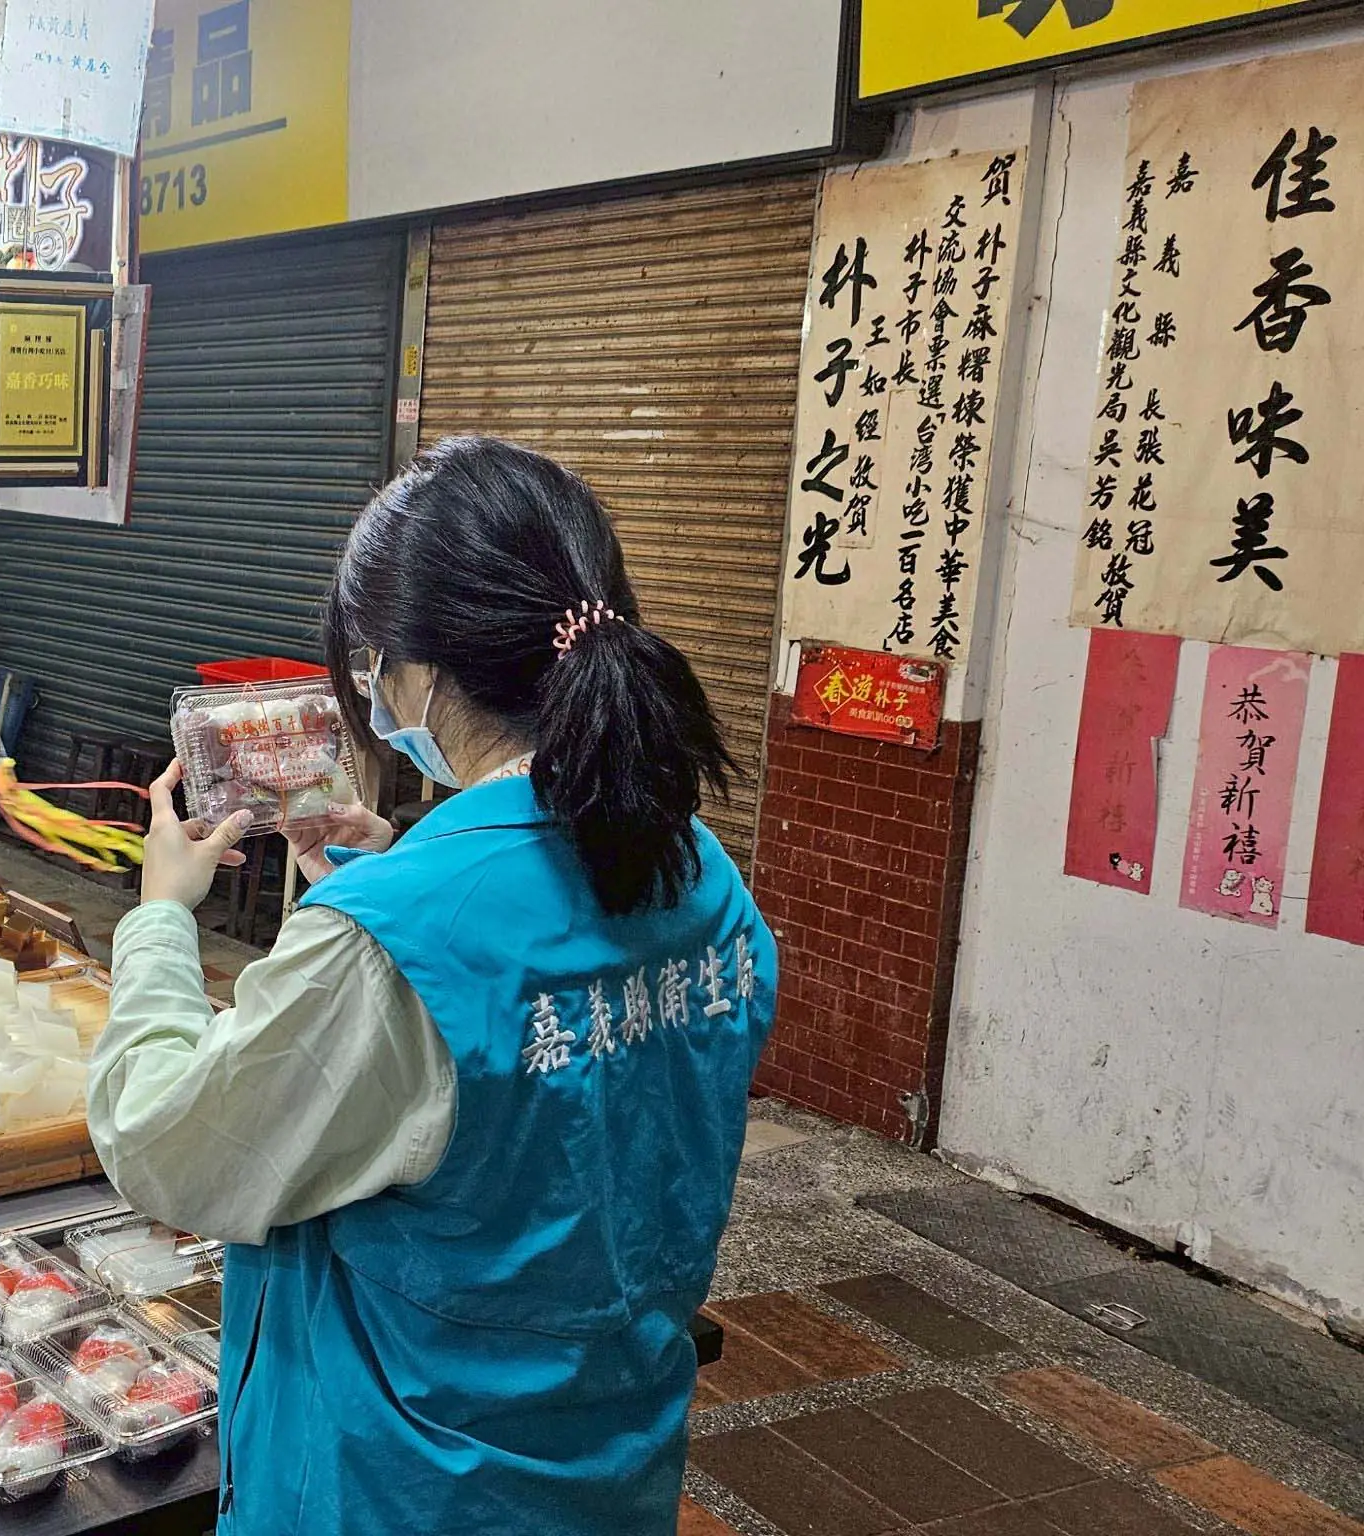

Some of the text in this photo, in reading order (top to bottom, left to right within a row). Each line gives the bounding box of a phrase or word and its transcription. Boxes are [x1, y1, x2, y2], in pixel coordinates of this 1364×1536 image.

[1209, 126, 1338, 592] 佳香味美
[1217, 683, 1277, 866] 恭賀新禧
